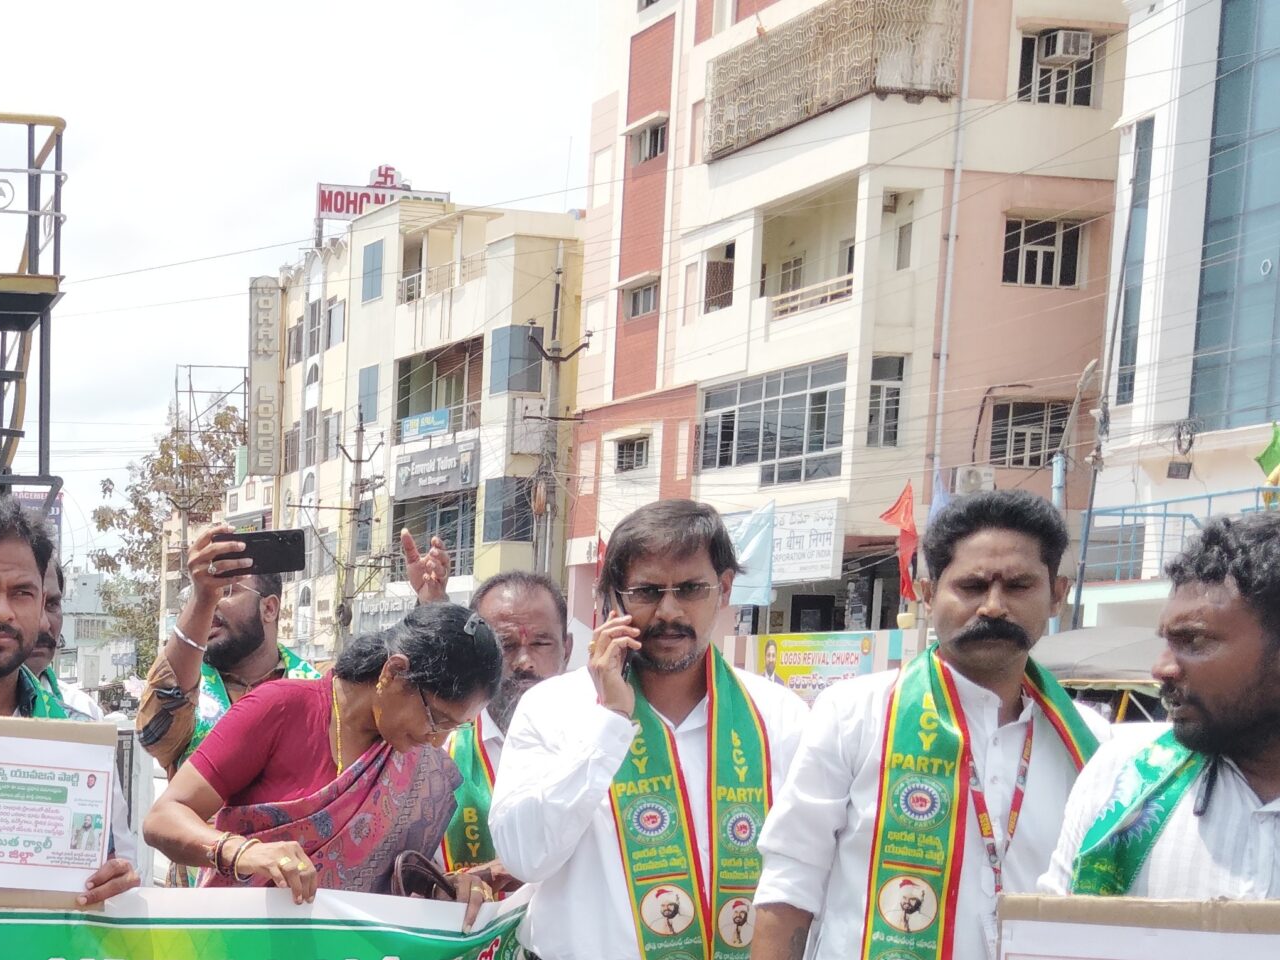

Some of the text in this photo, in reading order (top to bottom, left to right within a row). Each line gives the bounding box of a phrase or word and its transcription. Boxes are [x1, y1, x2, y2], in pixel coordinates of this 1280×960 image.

[256, 385, 275, 467] LODGE
[809, 527, 833, 548] निगम
[780, 651, 860, 666] LOGOS REVIVAL CHURCH
[10, 769, 56, 782] యువజన
[890, 752, 956, 778] PARTY
[615, 774, 673, 797] PARTY
[716, 785, 763, 803] PARTY
[463, 807, 480, 858] BCY
